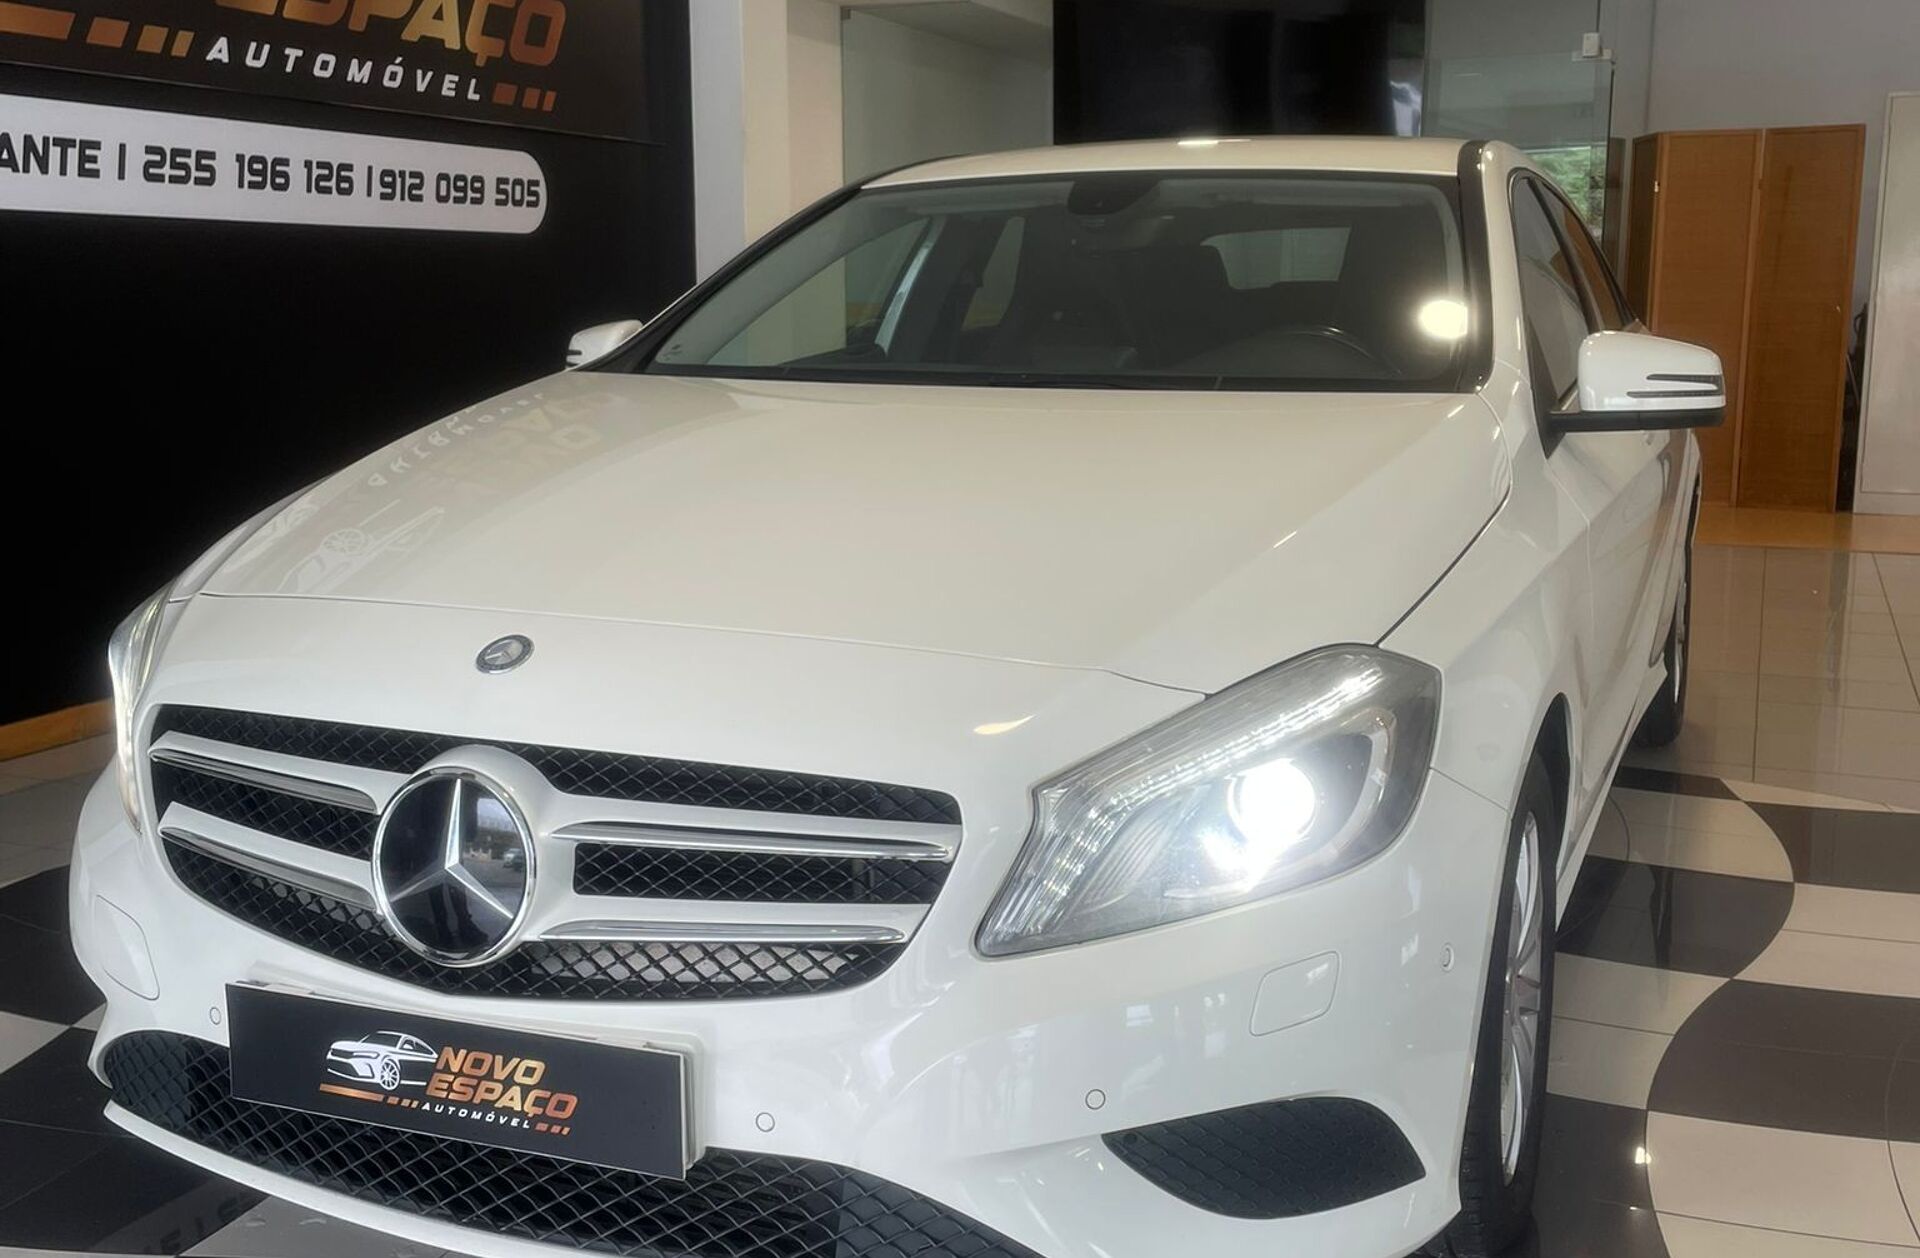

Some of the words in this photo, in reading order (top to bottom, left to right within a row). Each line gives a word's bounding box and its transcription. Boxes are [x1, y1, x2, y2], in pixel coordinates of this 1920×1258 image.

[214, 0, 567, 67] AÇO
[205, 36, 481, 101] AUTOMÓVEL
[0, 132, 102, 179] ANTE
[143, 144, 217, 187] 255
[235, 153, 291, 192] 196
[304, 159, 354, 197] 126
[435, 172, 486, 205] 099
[494, 177, 541, 208] 505
[435, 1046, 546, 1086] NOVO
[421, 1102, 530, 1129] AUTOMÓVEL
[425, 1072, 578, 1120] ESPAÇO
